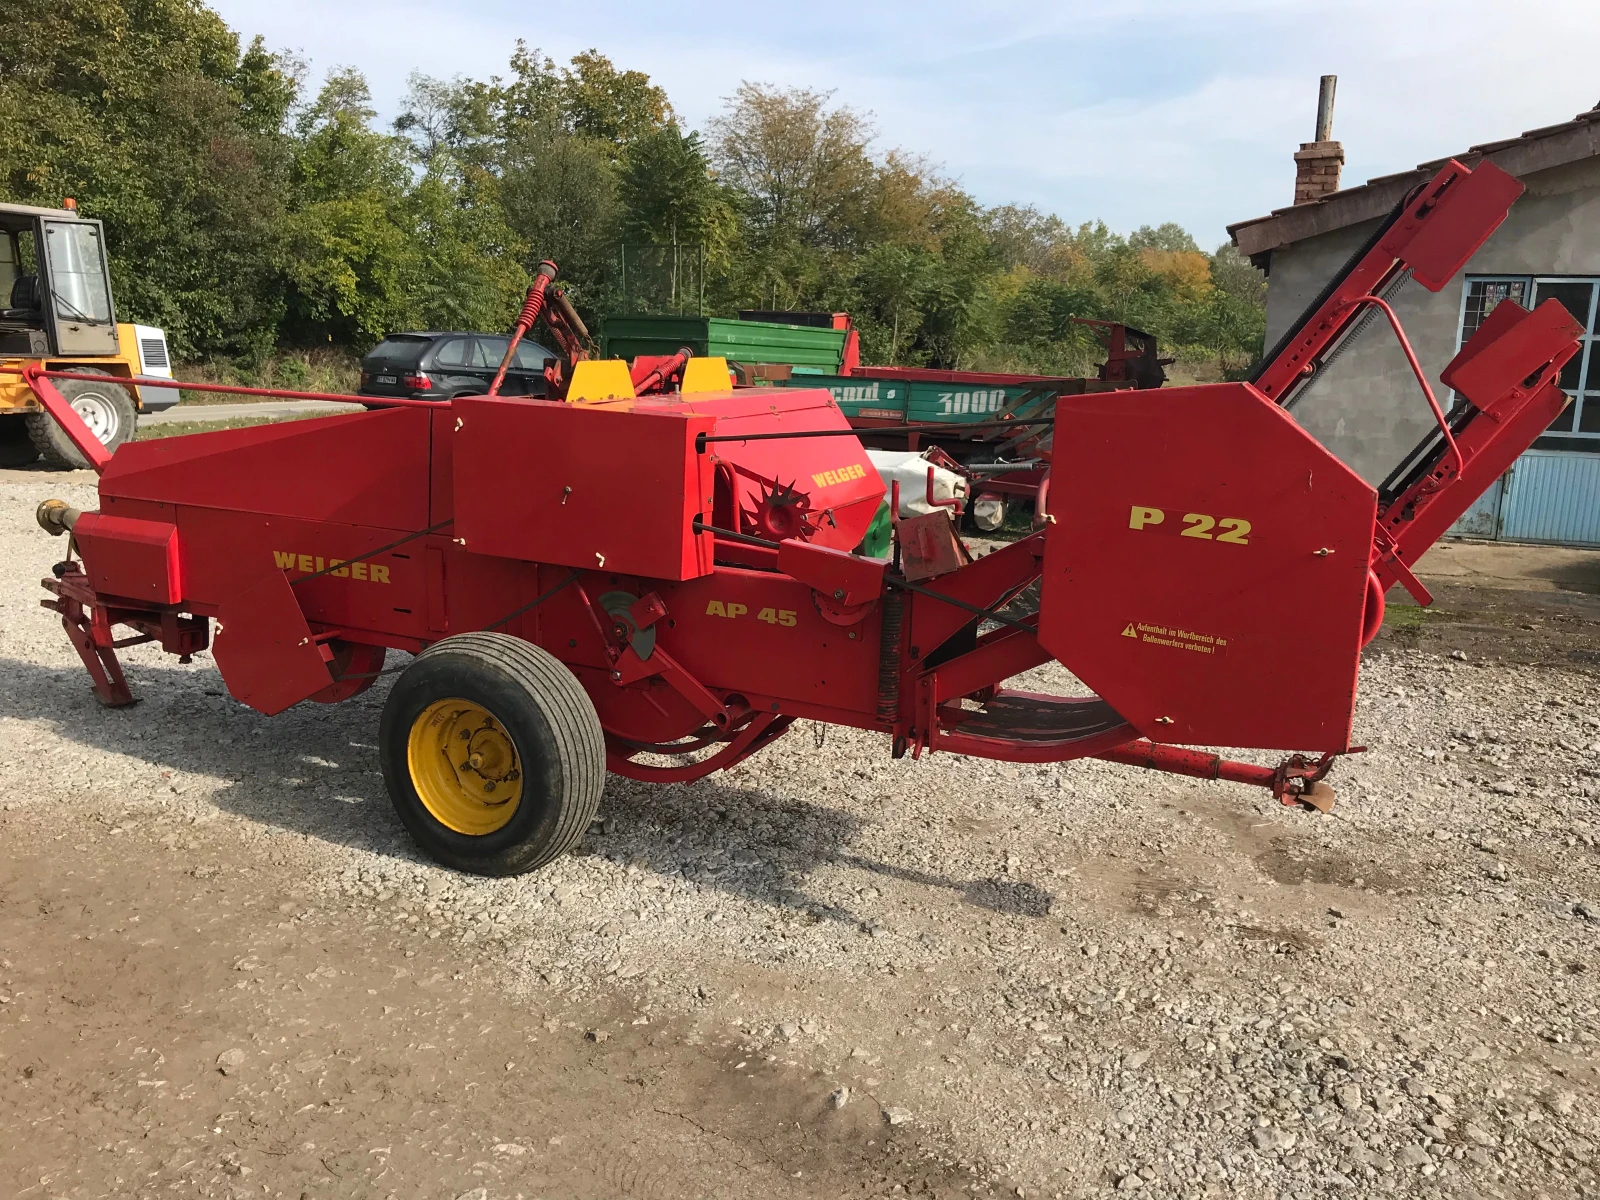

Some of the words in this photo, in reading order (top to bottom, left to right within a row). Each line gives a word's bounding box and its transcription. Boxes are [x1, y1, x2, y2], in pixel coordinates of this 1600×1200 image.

[935, 389, 1005, 415] 3000
[811, 463, 867, 488] WELGER
[1128, 505, 1165, 531] P
[1180, 513, 1252, 546] 22
[272, 550, 392, 585] WELGER
[705, 600, 748, 619] AP
[757, 607, 798, 627] 45
[1137, 622, 1167, 635] Aufenthalt
[1168, 627, 1176, 636] im
[1177, 629, 1213, 643] Wurfbereich
[1216, 637, 1227, 646] des
[1143, 634, 1184, 648] Ballenwerfers
